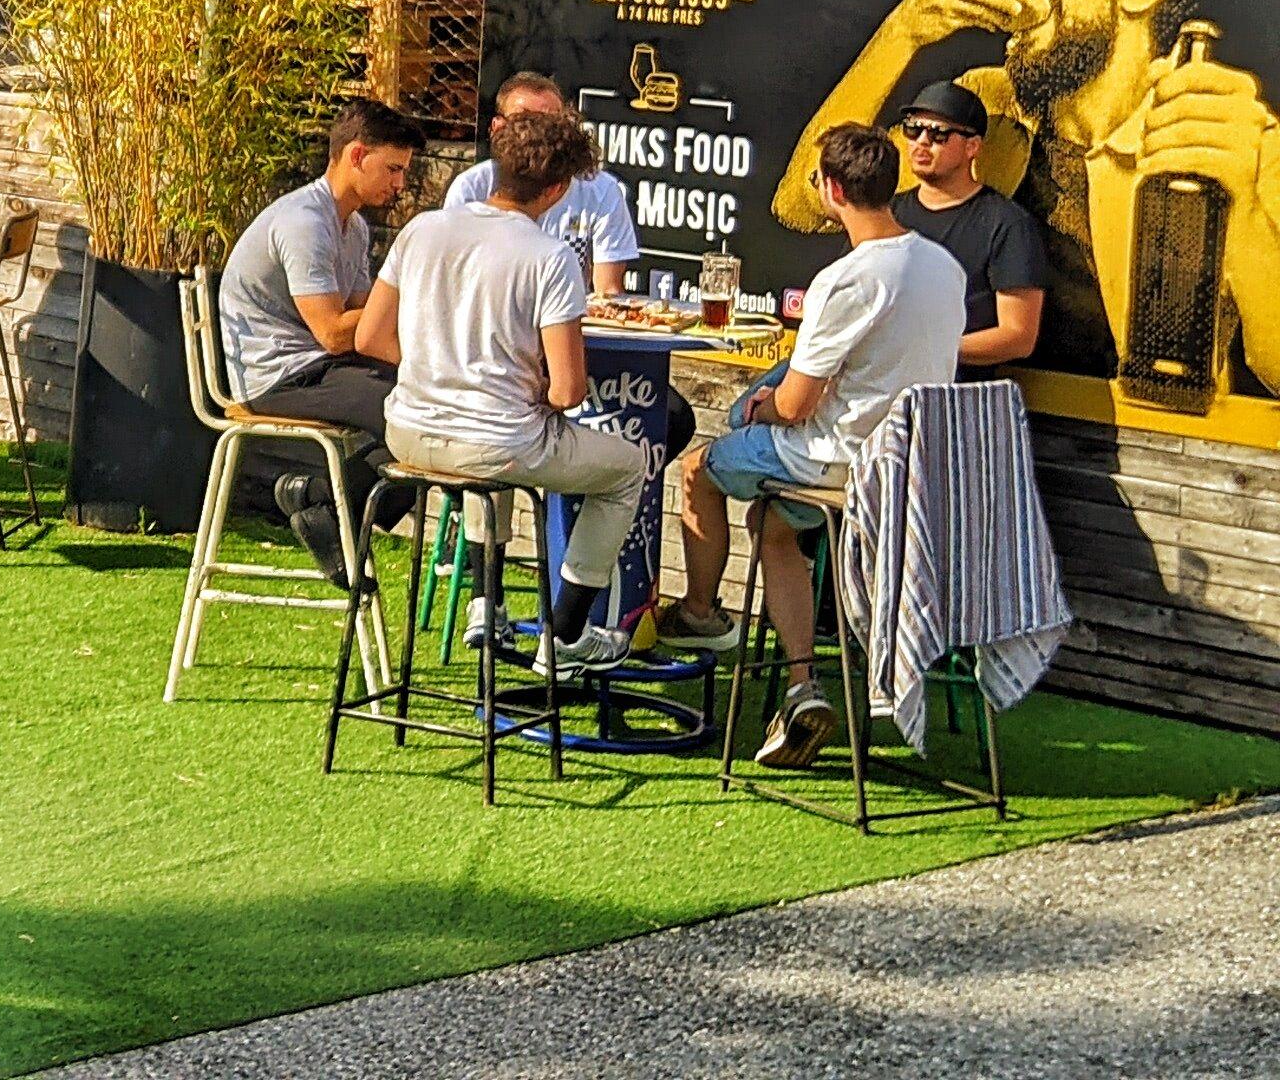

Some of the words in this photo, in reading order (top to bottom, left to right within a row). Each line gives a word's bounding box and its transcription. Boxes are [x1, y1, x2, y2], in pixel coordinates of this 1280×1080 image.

[628, 6, 643, 21] 74
[582, 122, 666, 168] INKS
[673, 126, 751, 178] FOOD
[636, 180, 737, 242] MUSIC
